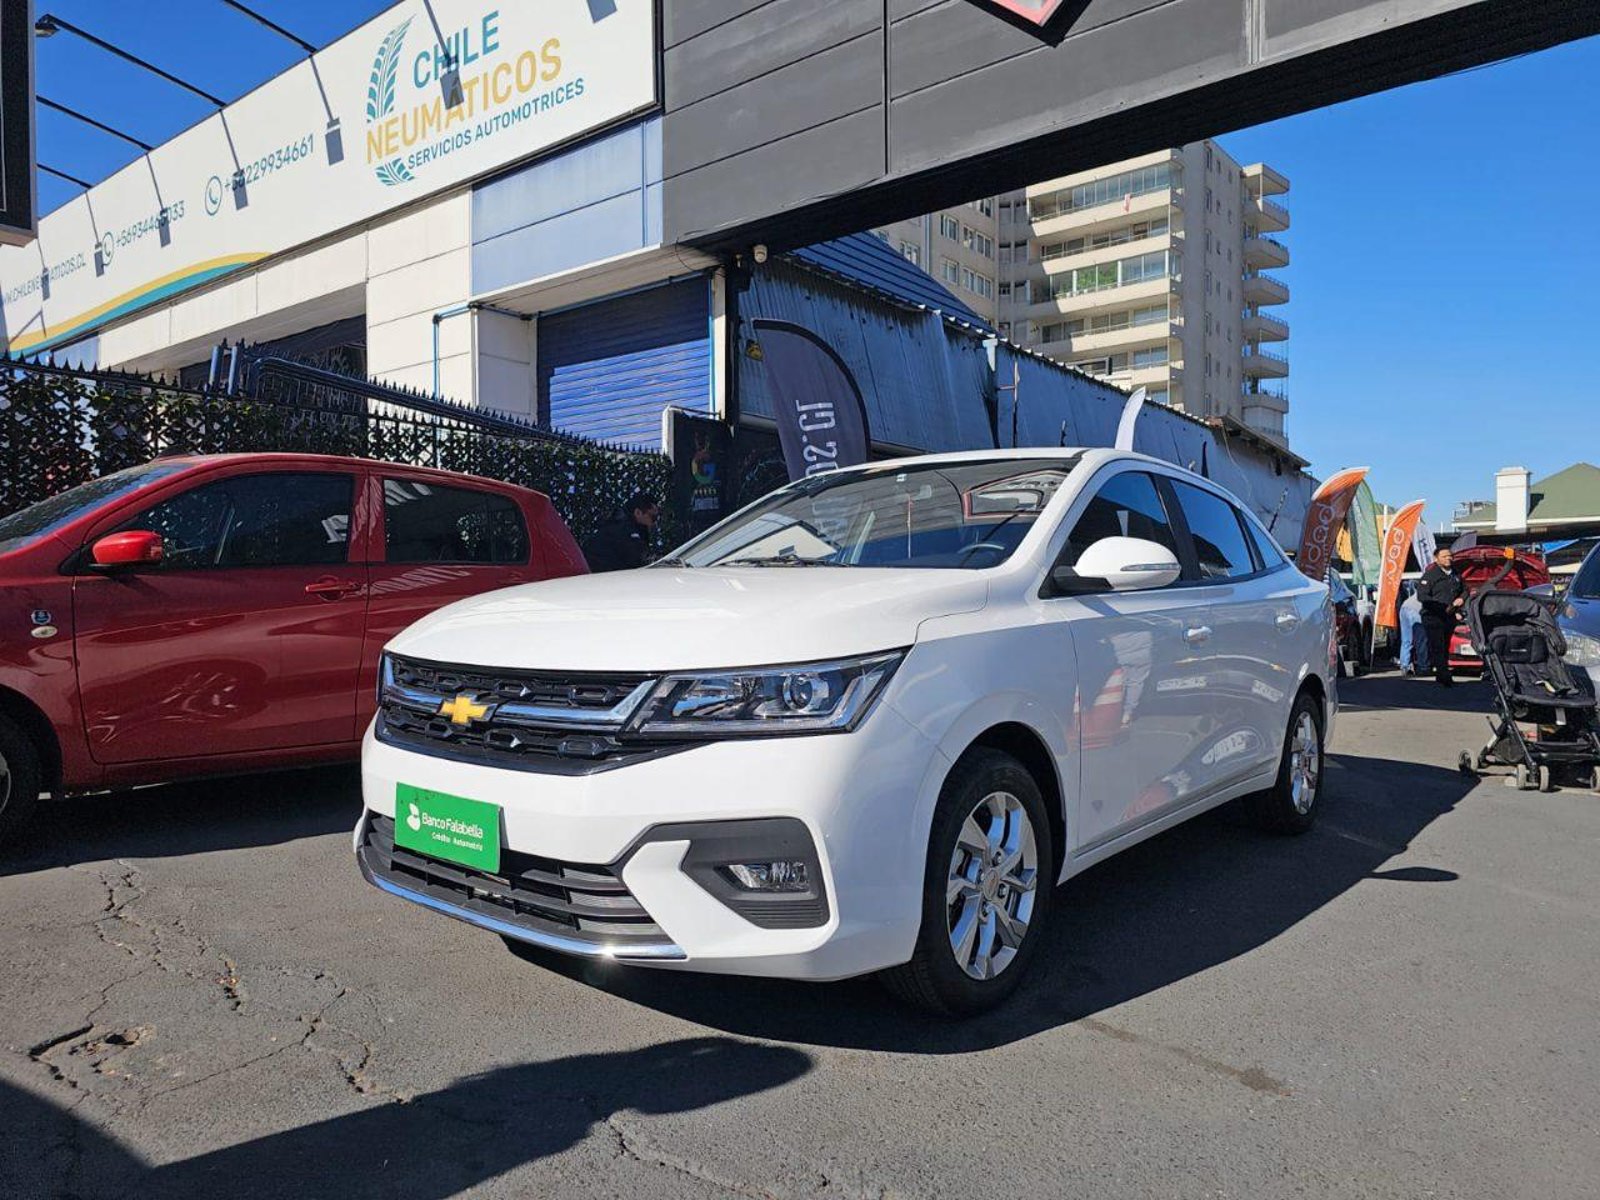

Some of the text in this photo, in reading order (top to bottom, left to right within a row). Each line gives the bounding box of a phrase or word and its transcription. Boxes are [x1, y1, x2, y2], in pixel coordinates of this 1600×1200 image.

[413, 10, 499, 89] CHILE
[407, 78, 585, 170] SERVICIOS AUTOMOTRICES
